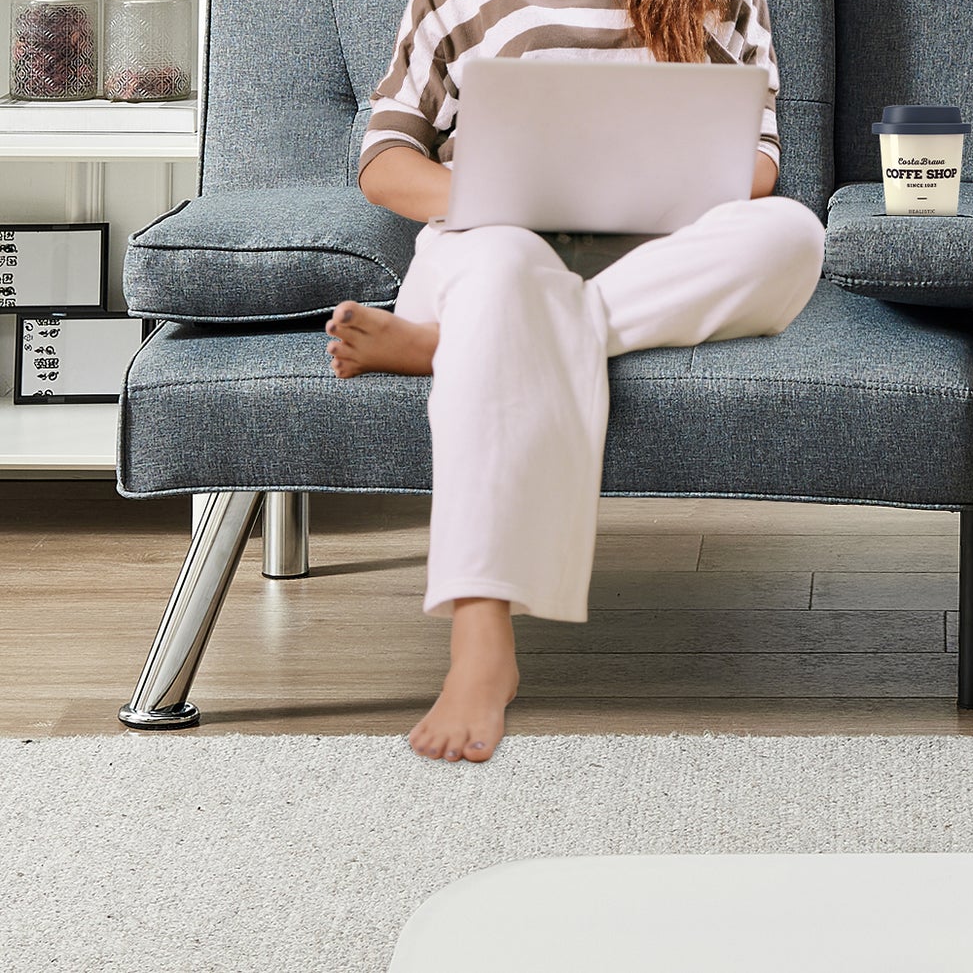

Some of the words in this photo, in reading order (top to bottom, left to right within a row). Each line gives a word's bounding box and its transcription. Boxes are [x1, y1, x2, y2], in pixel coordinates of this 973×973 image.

[898, 157, 920, 166] Costa
[920, 157, 946, 166] Brava
[886, 168, 923, 180] COFFE
[926, 168, 958, 180] SHOP
